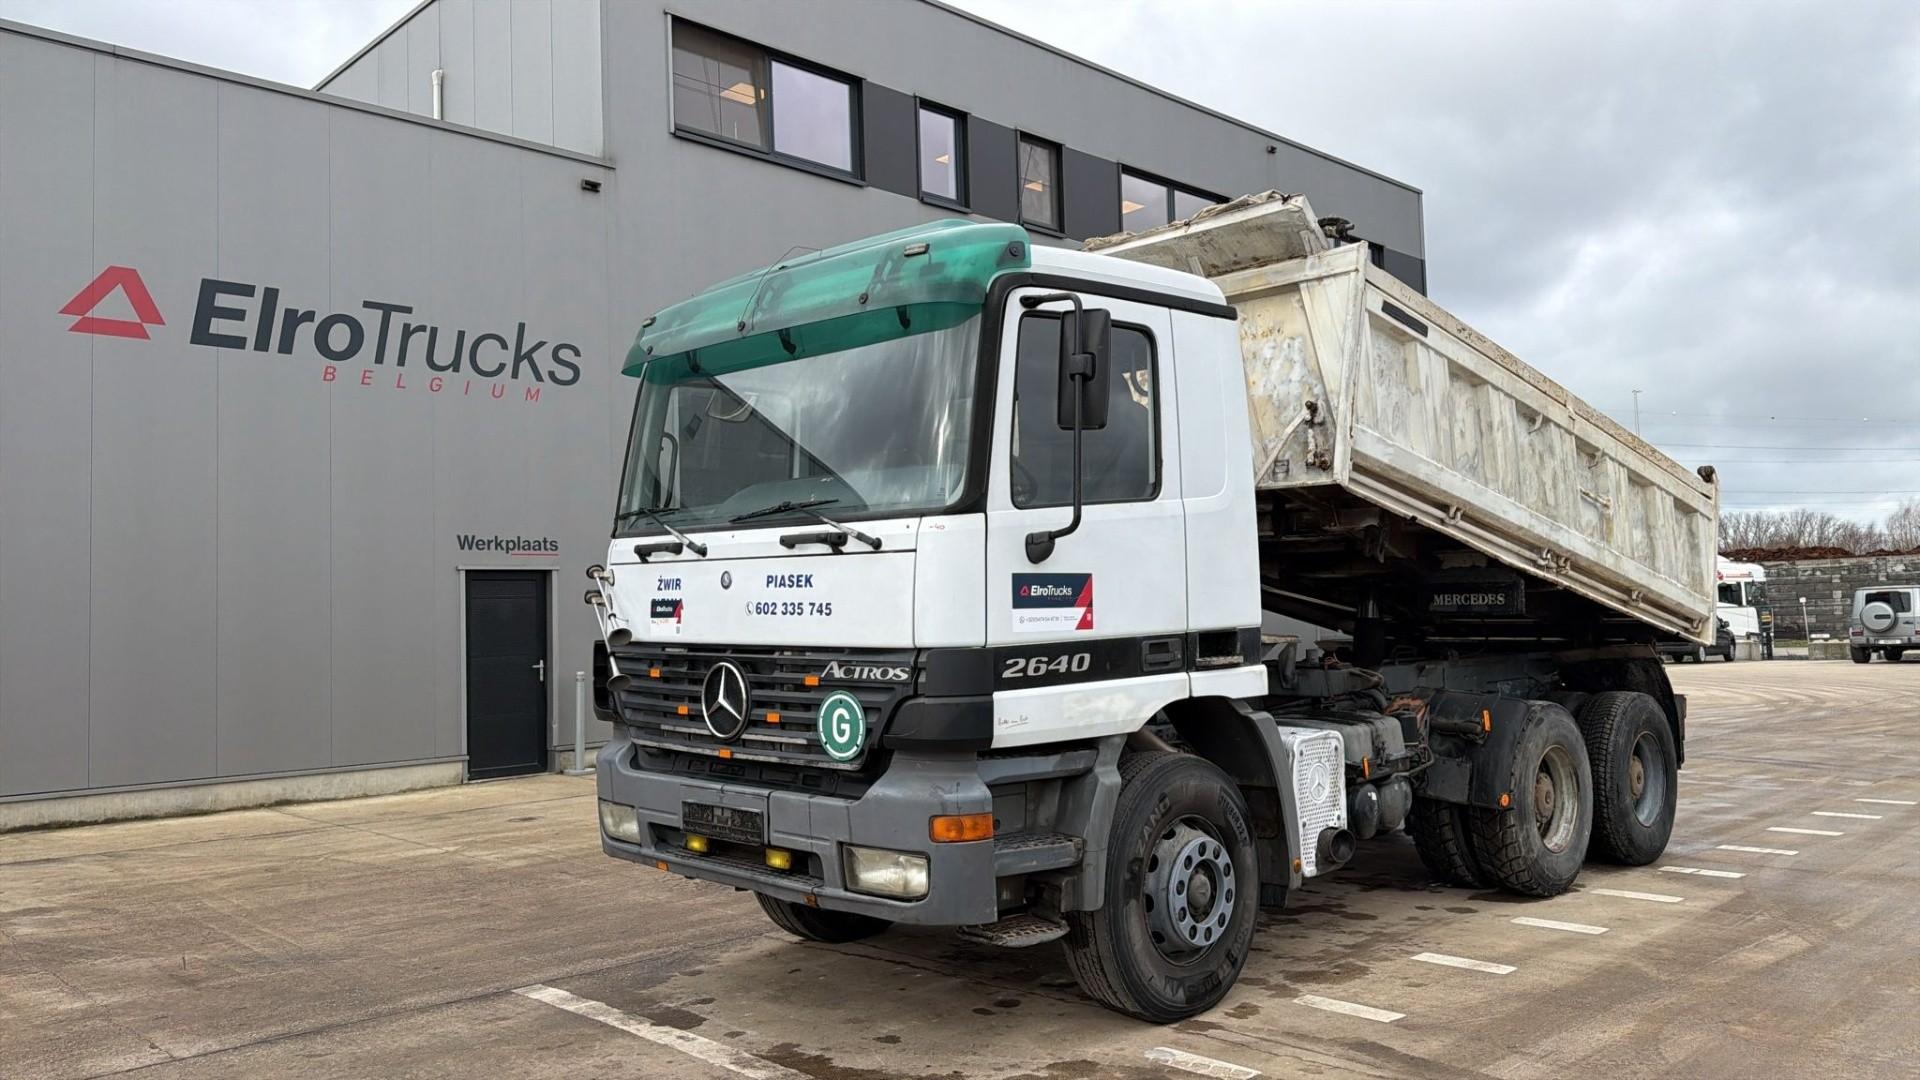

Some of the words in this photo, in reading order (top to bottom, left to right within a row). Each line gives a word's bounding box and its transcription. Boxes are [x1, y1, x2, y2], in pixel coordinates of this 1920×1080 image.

[189, 277, 582, 387] ElroTrucks
[322, 365, 542, 403] BELGIUM
[456, 534, 560, 555] Werkplaats
[656, 575, 682, 591] ŻWIR
[766, 574, 814, 588] PIASEK
[1030, 584, 1073, 597] ElroTrucks
[1433, 593, 1506, 606] MERCEDES
[755, 601, 777, 616] 602
[781, 602, 804, 616] 335
[808, 602, 832, 617] 745
[1001, 653, 1091, 679] 2640
[832, 707, 851, 744] G
